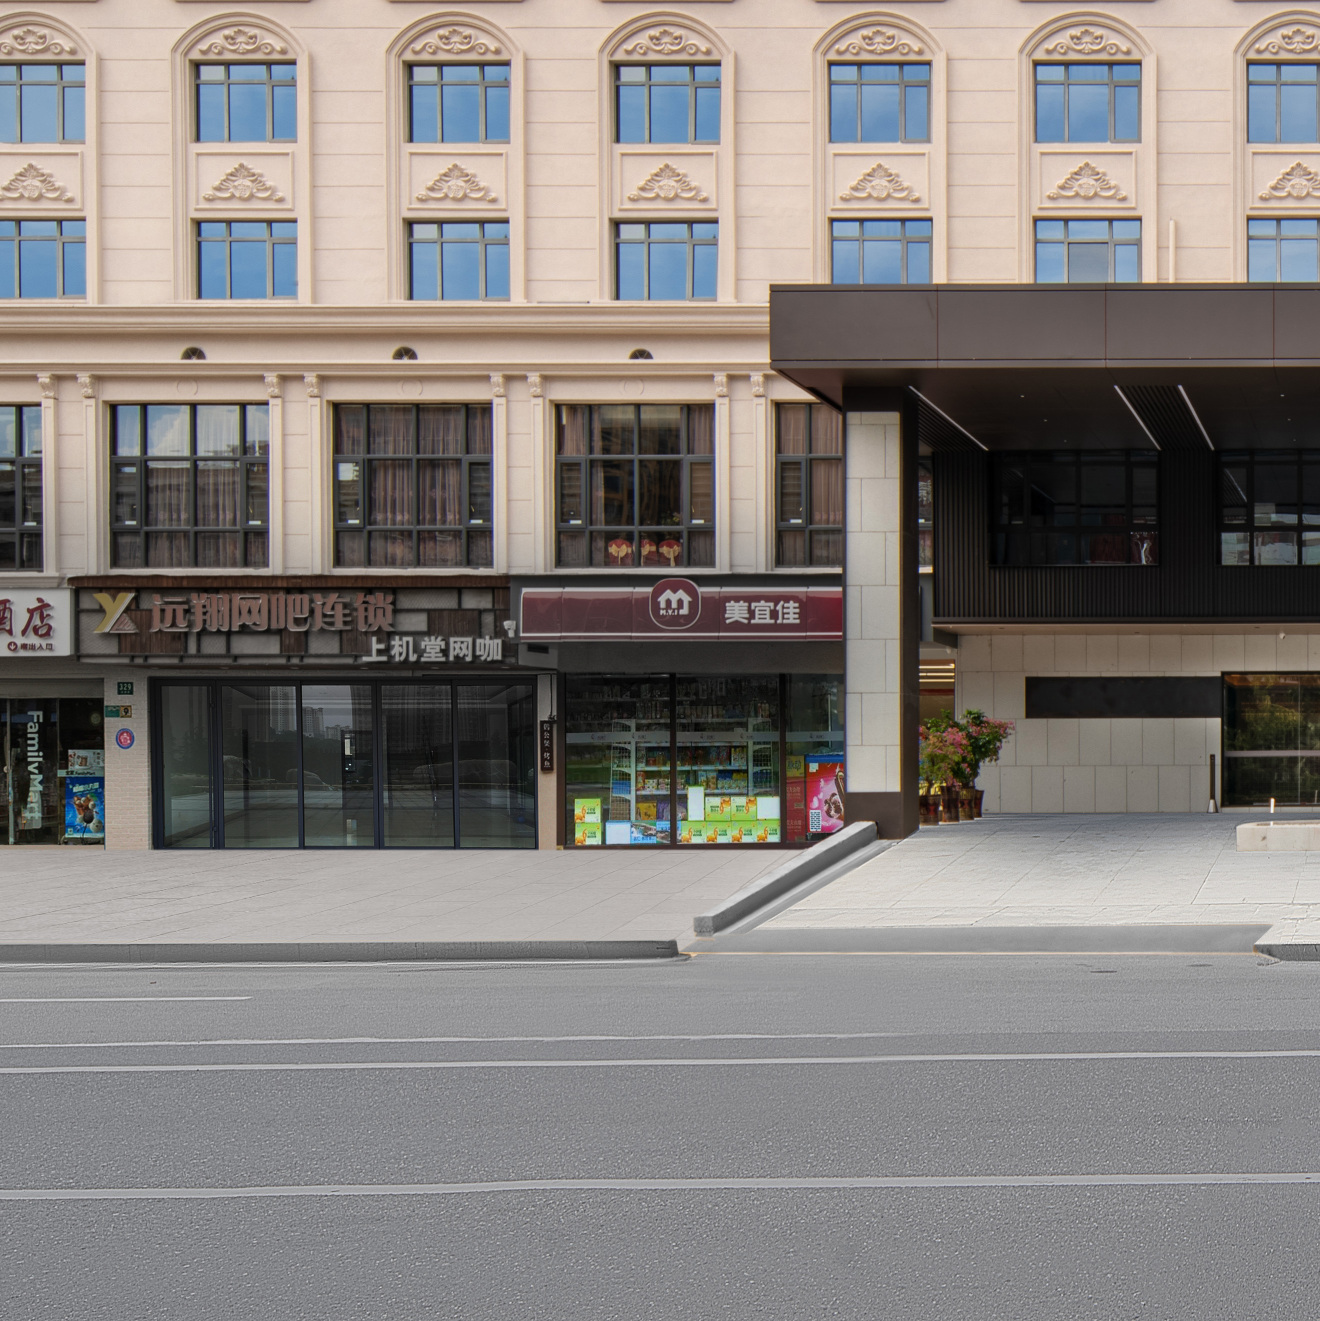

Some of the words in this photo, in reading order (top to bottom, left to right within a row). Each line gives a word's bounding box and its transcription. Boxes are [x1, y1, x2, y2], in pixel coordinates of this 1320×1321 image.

[149, 592, 395, 632] 远翔网吧连锁
[724, 600, 801, 624] 美宜佳
[362, 635, 503, 663] 上机堂网咖
[119, 683, 132, 691] 329
